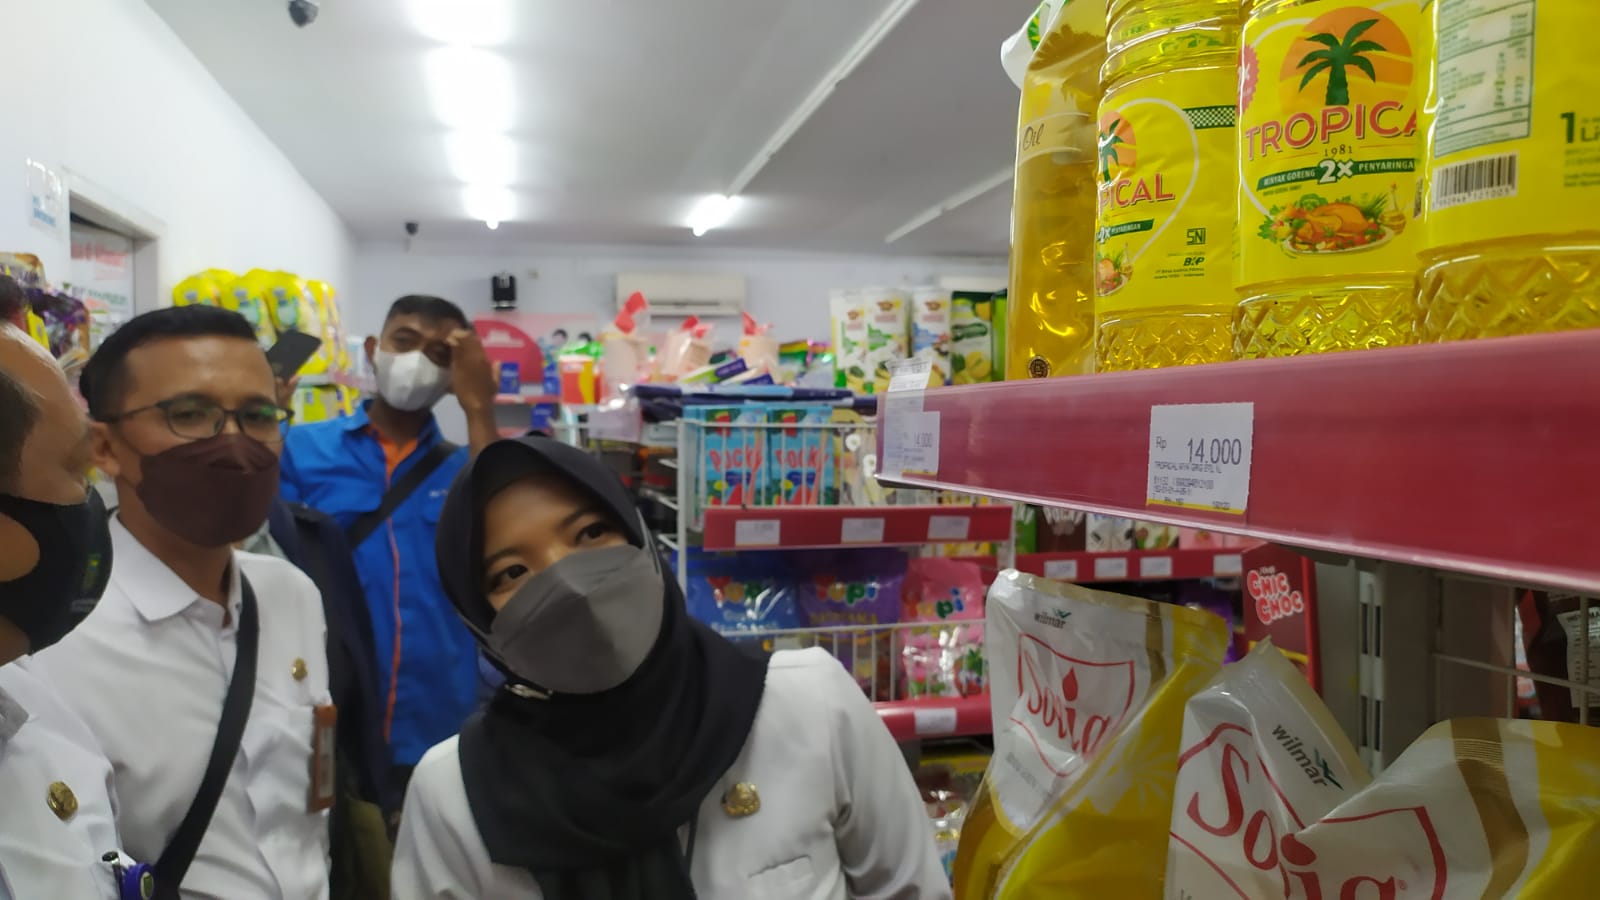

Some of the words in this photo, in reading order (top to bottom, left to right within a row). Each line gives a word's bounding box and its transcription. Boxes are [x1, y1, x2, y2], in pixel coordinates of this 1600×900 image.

[1023, 123, 1044, 151] Oil
[1324, 144, 1352, 158] 1981
[1287, 169, 1316, 181] GORENG
[1187, 228, 1206, 246] SNI
[1156, 436, 1167, 450] Rp
[1187, 437, 1242, 466] 14.000
[1271, 722, 1330, 789] wilmar
